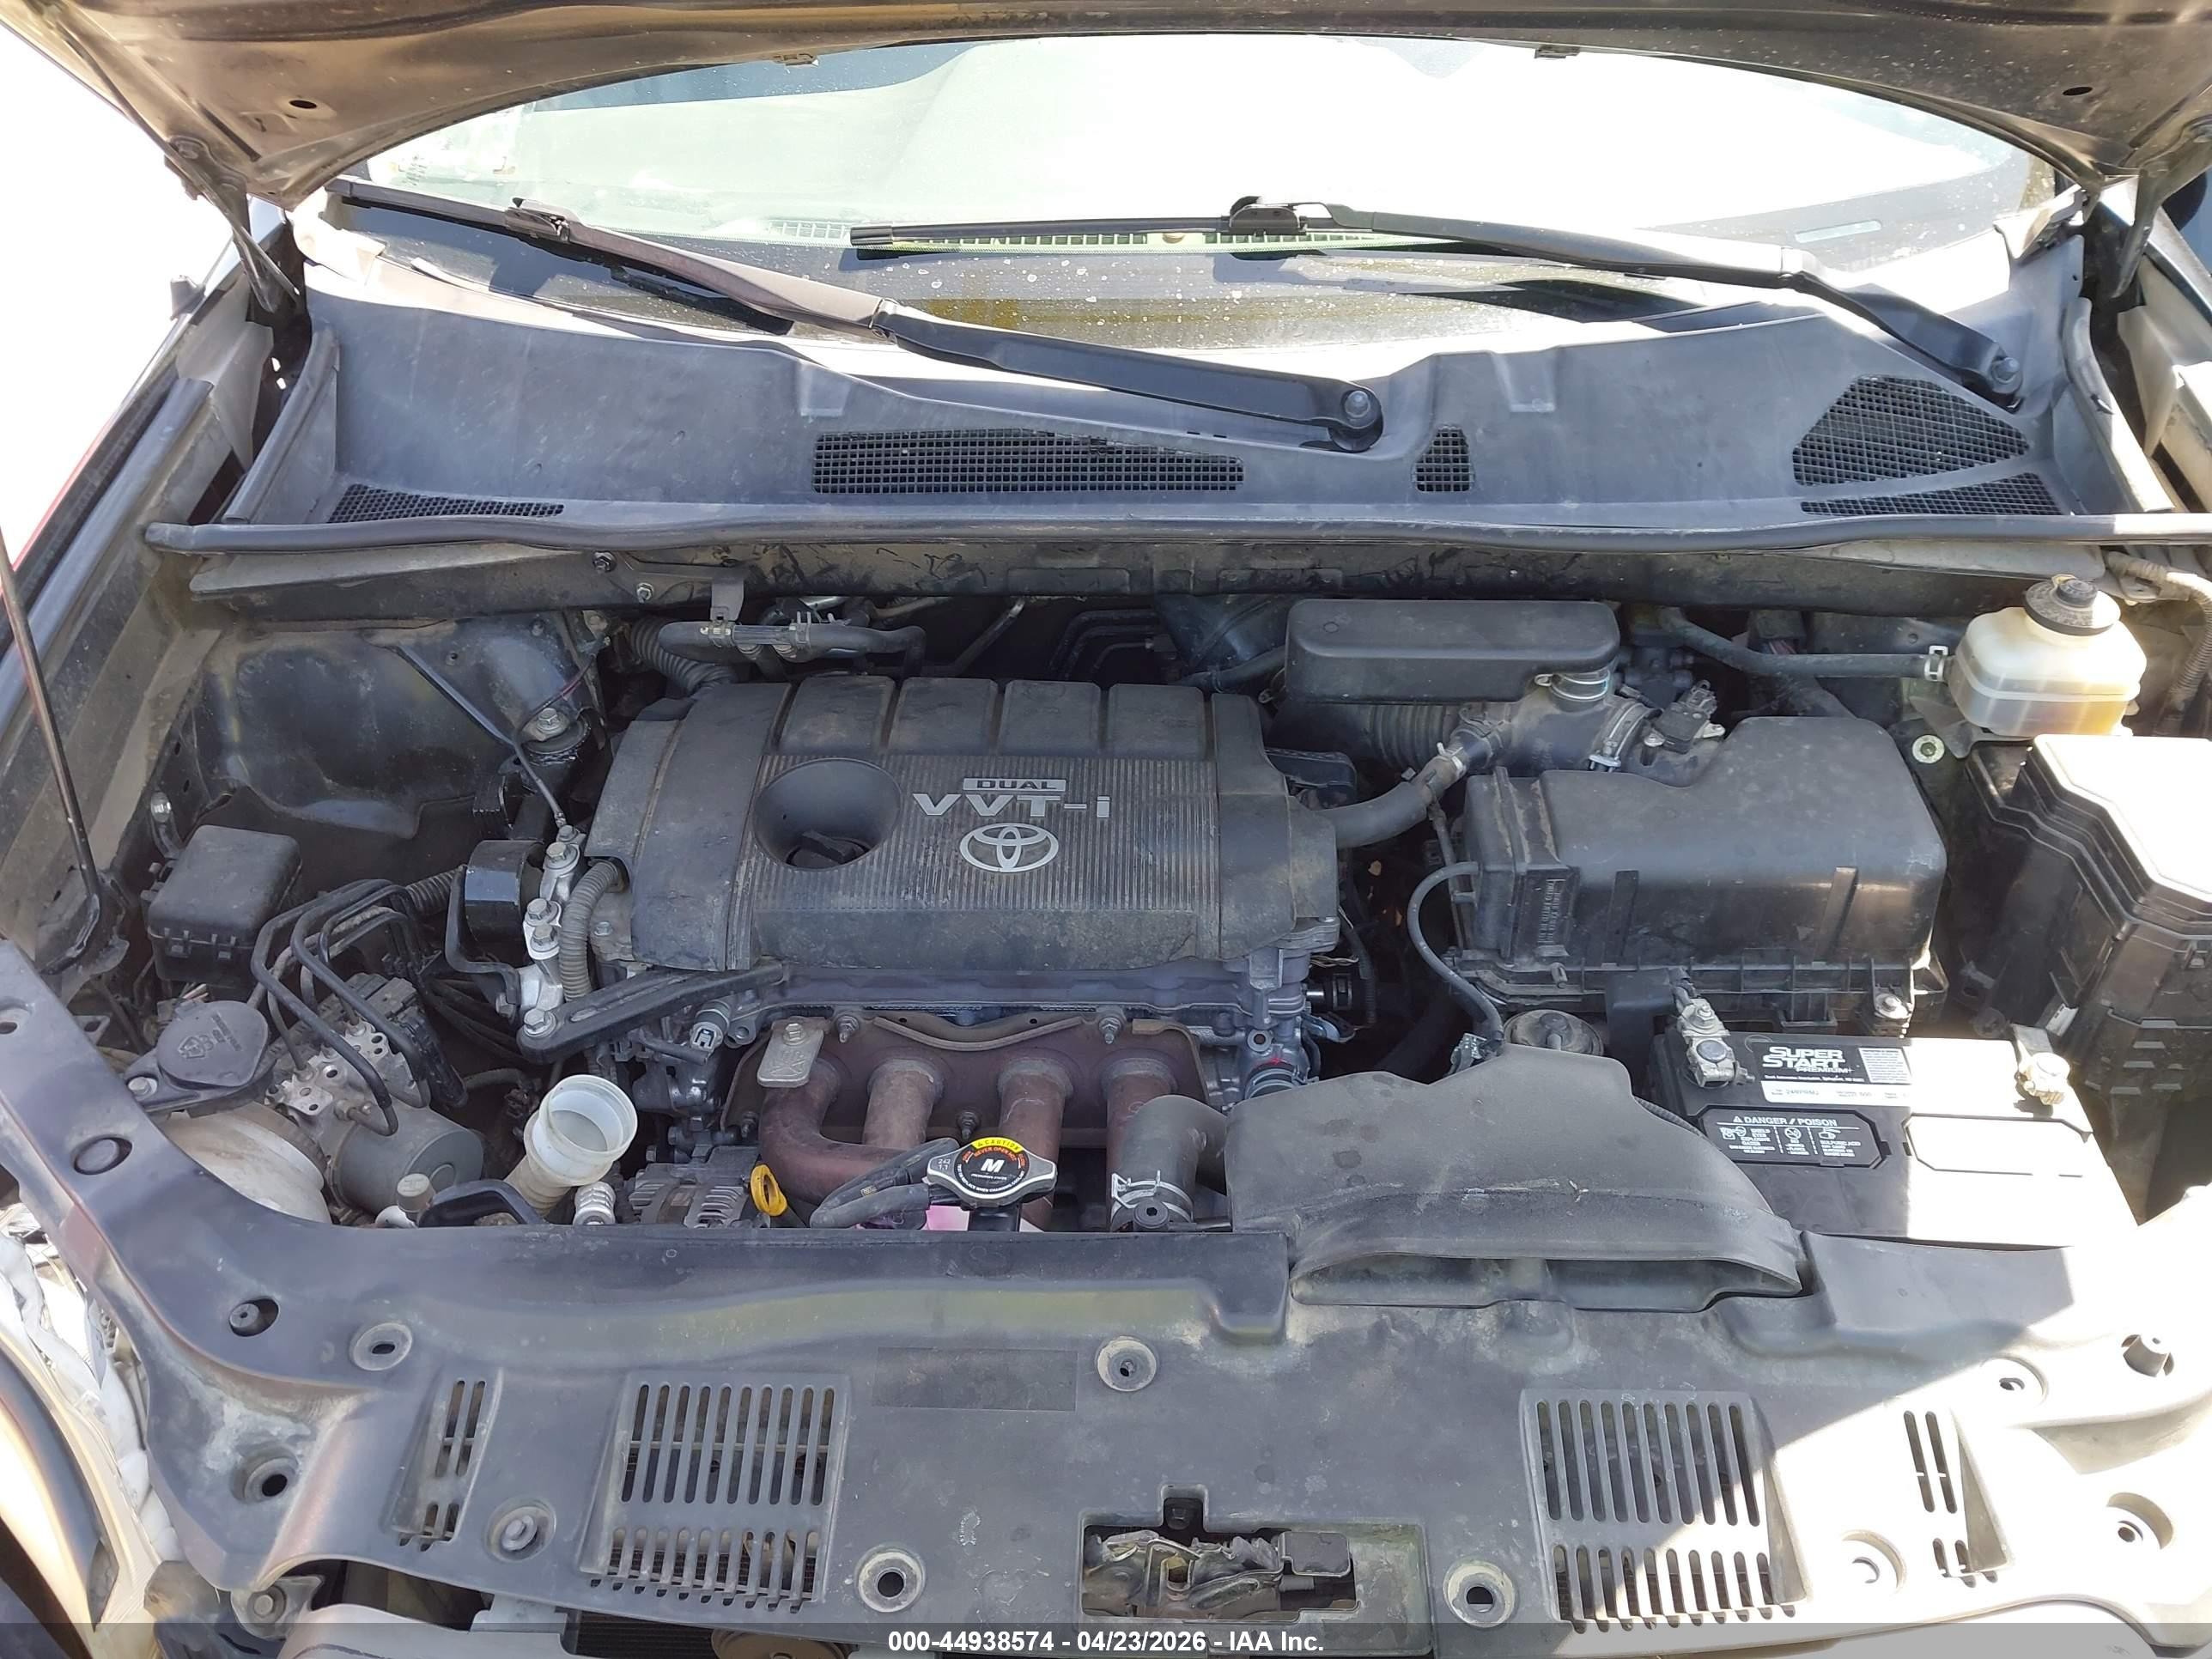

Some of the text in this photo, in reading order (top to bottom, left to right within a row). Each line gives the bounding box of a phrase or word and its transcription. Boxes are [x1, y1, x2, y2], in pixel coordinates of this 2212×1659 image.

[975, 780, 1058, 790] DUAL
[913, 793, 1110, 817] VVT-i
[1769, 1046, 1844, 1059] SUPER
[1762, 1054, 1846, 1068] START
[1744, 1116, 1788, 1125] DANGER
[1797, 1118, 1838, 1127] POISON
[984, 1139, 1020, 1151] CAUTION
[980, 1158, 1005, 1173] M
